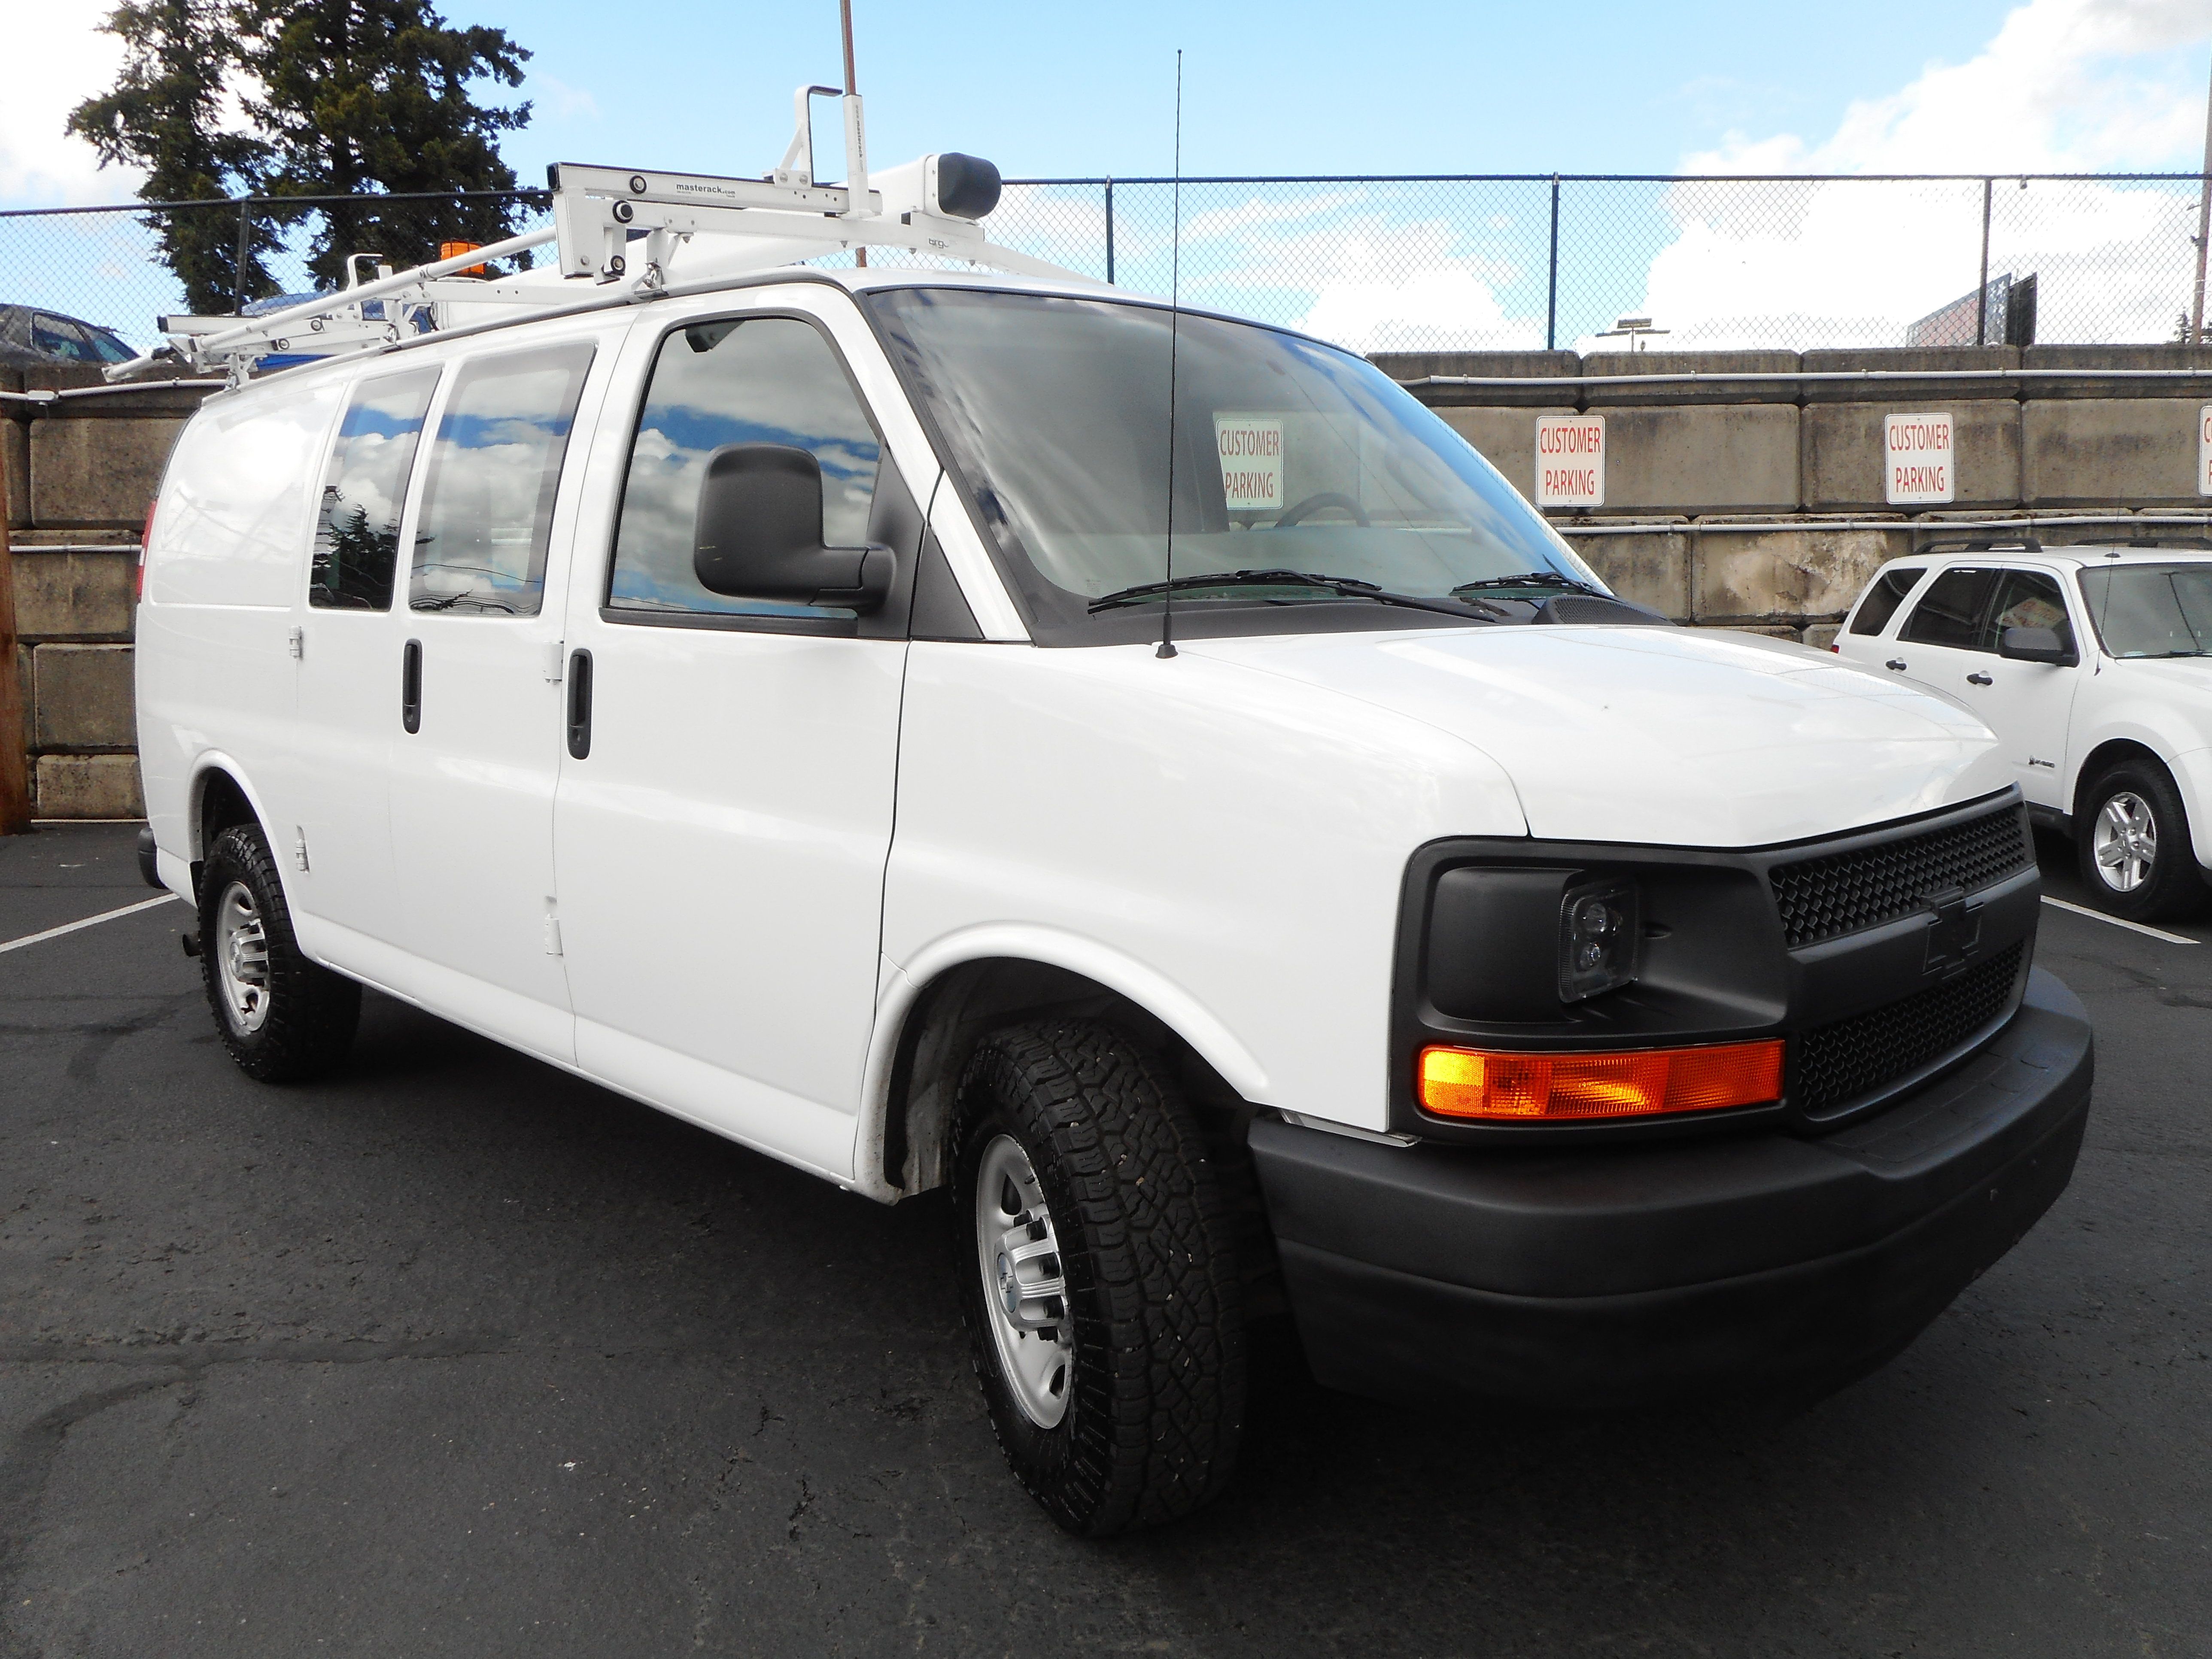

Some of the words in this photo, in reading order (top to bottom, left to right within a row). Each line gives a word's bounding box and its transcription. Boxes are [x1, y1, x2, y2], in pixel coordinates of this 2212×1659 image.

[676, 184, 735, 194] masterack.com
[1220, 430, 1279, 456] CUSTOMER
[1540, 427, 1600, 453] CUSTOMER
[1890, 424, 1949, 451] CUSTOMER
[1225, 472, 1273, 498] PARKING
[1546, 469, 1594, 495] PARKING
[1896, 466, 1944, 492] PARKING
